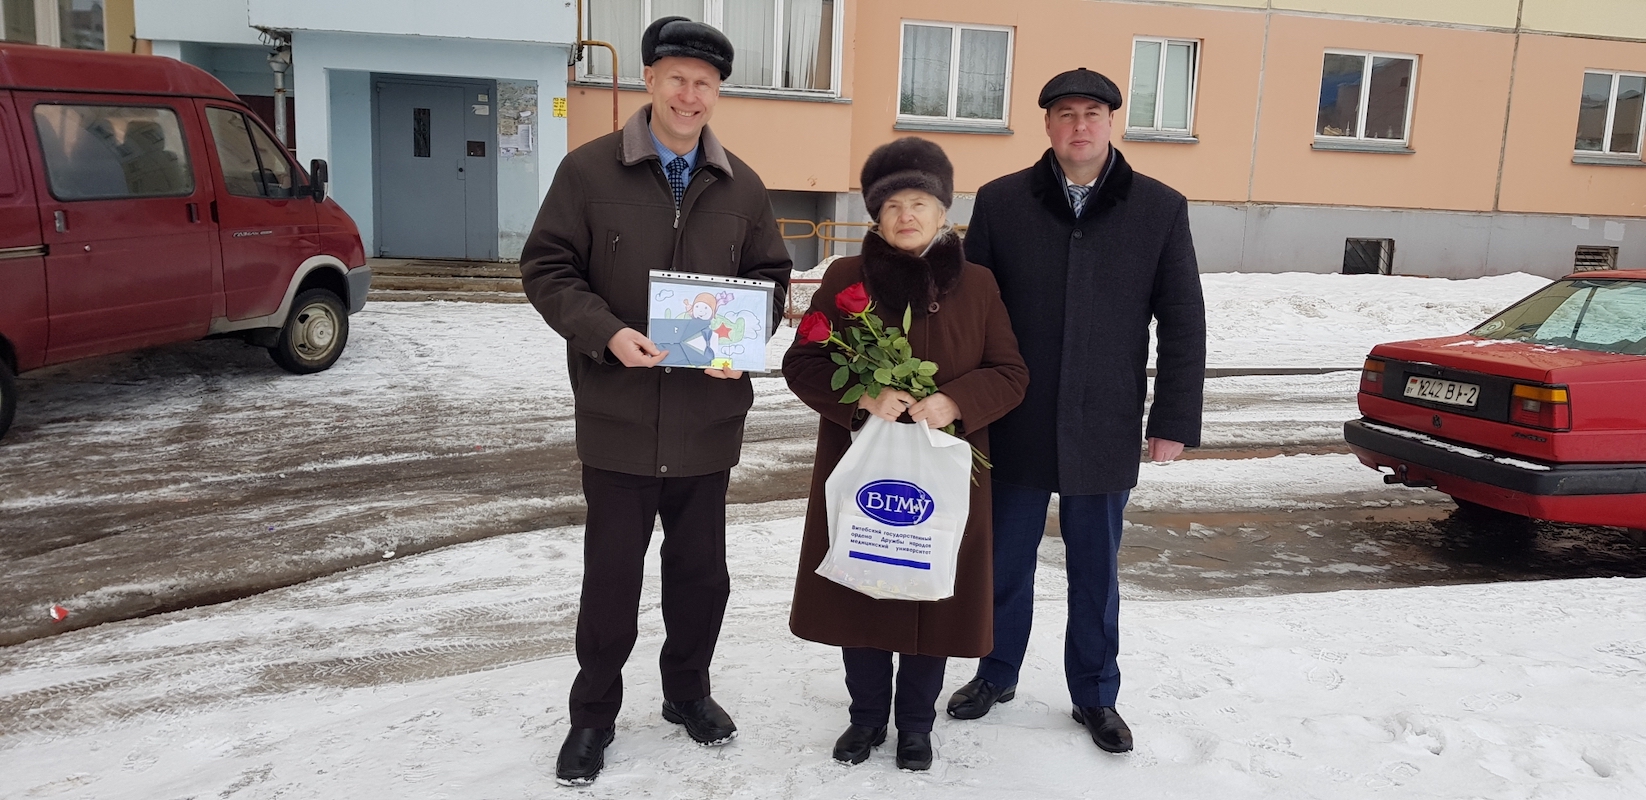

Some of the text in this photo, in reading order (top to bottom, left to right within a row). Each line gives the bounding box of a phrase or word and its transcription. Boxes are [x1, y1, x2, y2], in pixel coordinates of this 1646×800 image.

[1406, 386, 1414, 394] BY
[852, 525, 932, 541] Витебский государственный
[850, 539, 932, 555] медицинский университет
